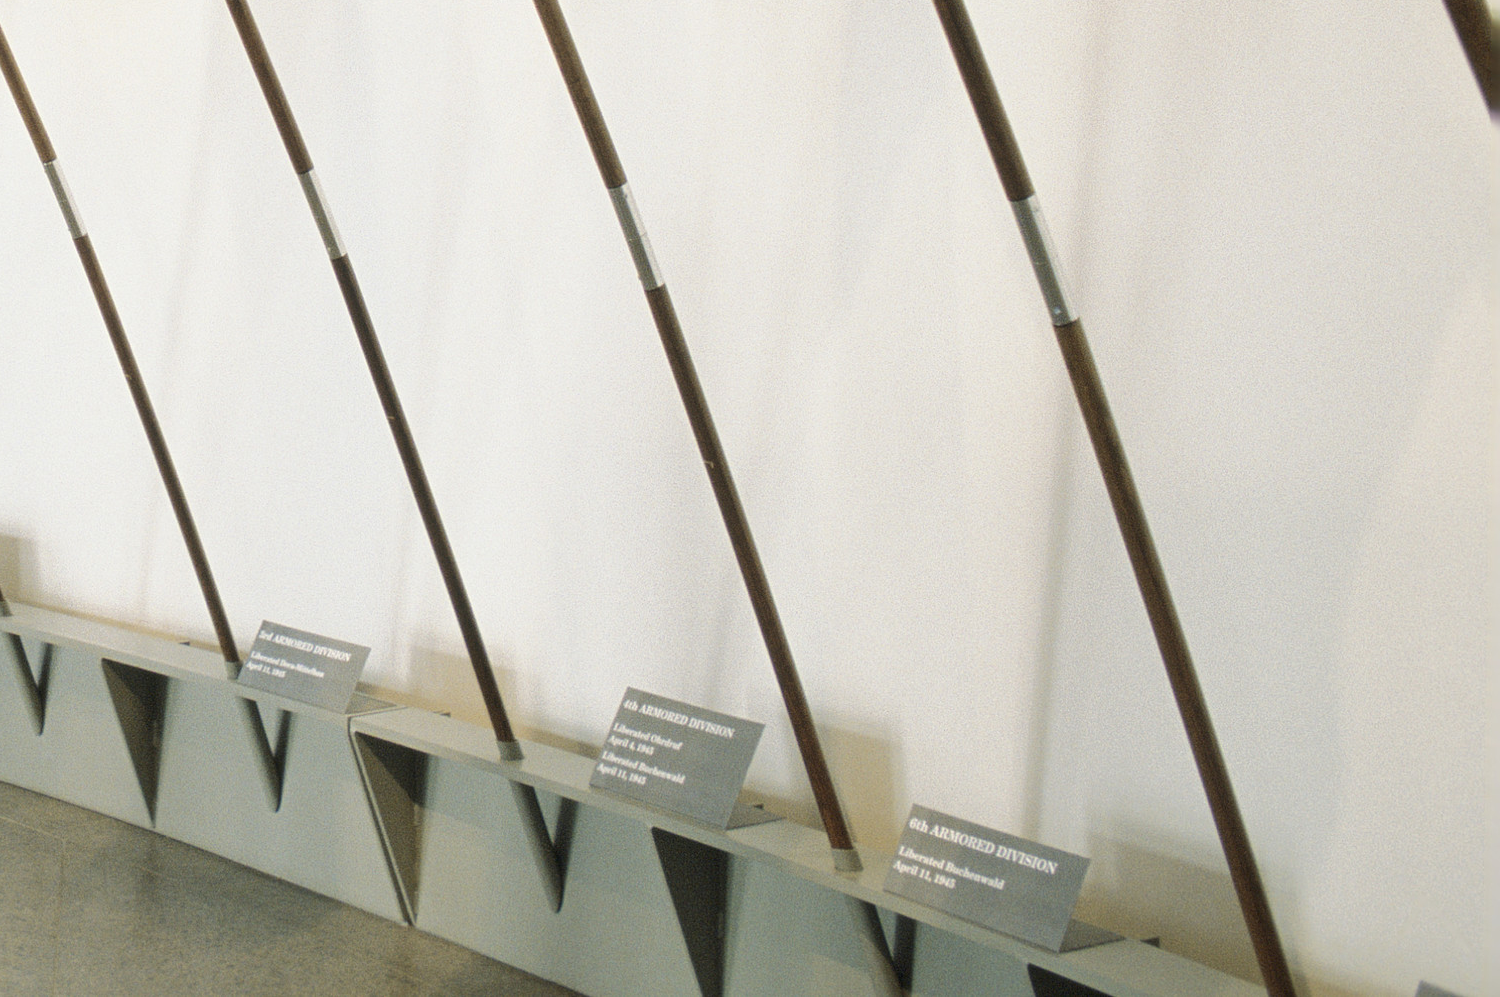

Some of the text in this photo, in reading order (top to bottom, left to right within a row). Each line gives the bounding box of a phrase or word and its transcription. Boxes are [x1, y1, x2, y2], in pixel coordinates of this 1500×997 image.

[273, 633, 314, 652] ARMORED
[313, 643, 352, 662] DIVISION
[613, 722, 651, 742] Liberated
[624, 700, 735, 739] 4th ARMORED DIVISION
[609, 736, 628, 748] April
[598, 763, 617, 775] April
[601, 750, 686, 785] Liberated Buchenwald
[909, 818, 1059, 875] 6th ARMORED DIVISION
[894, 861, 957, 889] April 11, 1945
[898, 845, 1005, 890] Liberated Buchenwald
